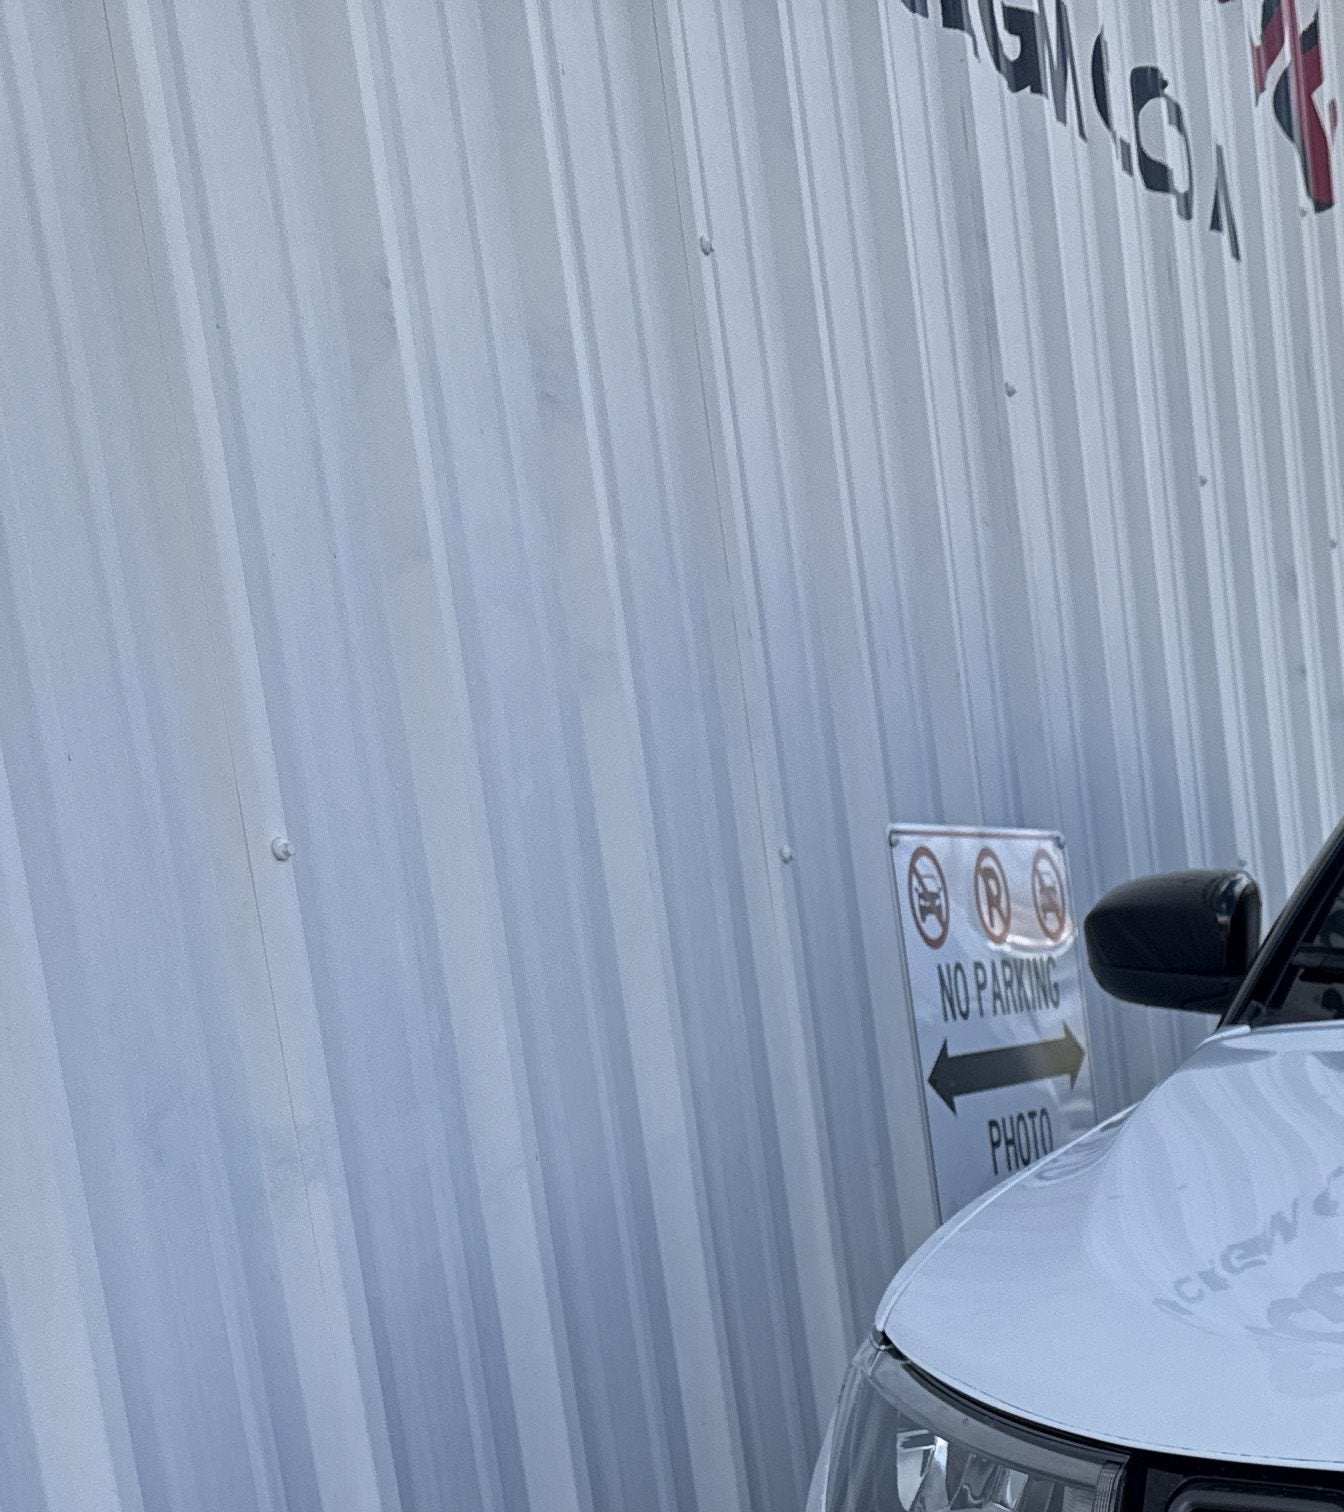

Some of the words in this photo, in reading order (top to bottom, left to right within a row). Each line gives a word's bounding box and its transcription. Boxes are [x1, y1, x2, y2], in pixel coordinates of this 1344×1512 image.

[937, 961, 970, 1022] NO
[973, 956, 1060, 1018] PARKING
[987, 1107, 1055, 1176] PHOTO
